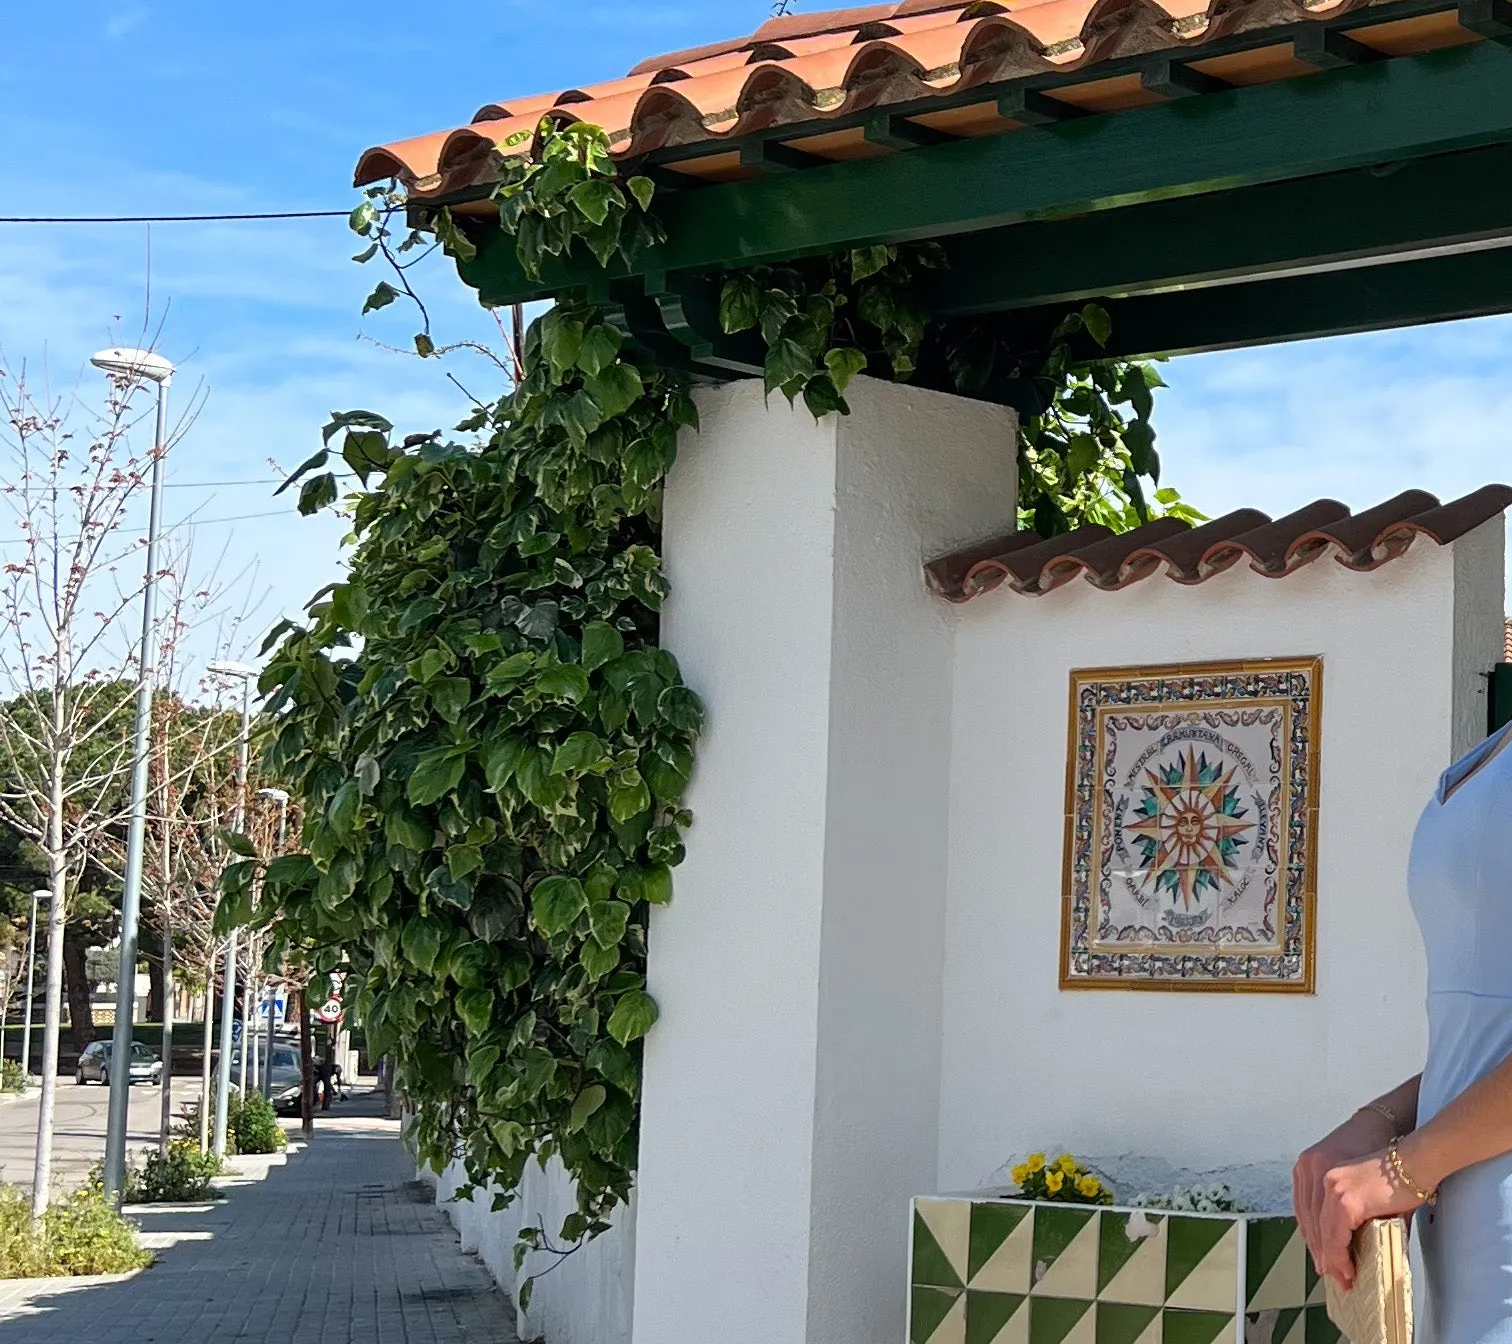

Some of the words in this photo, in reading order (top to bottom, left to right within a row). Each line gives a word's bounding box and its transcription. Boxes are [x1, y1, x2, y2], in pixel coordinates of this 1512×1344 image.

[1128, 747, 1158, 779] MESTRAL
[1114, 802, 1124, 852] PONENT
[323, 1004, 339, 1014] 40
